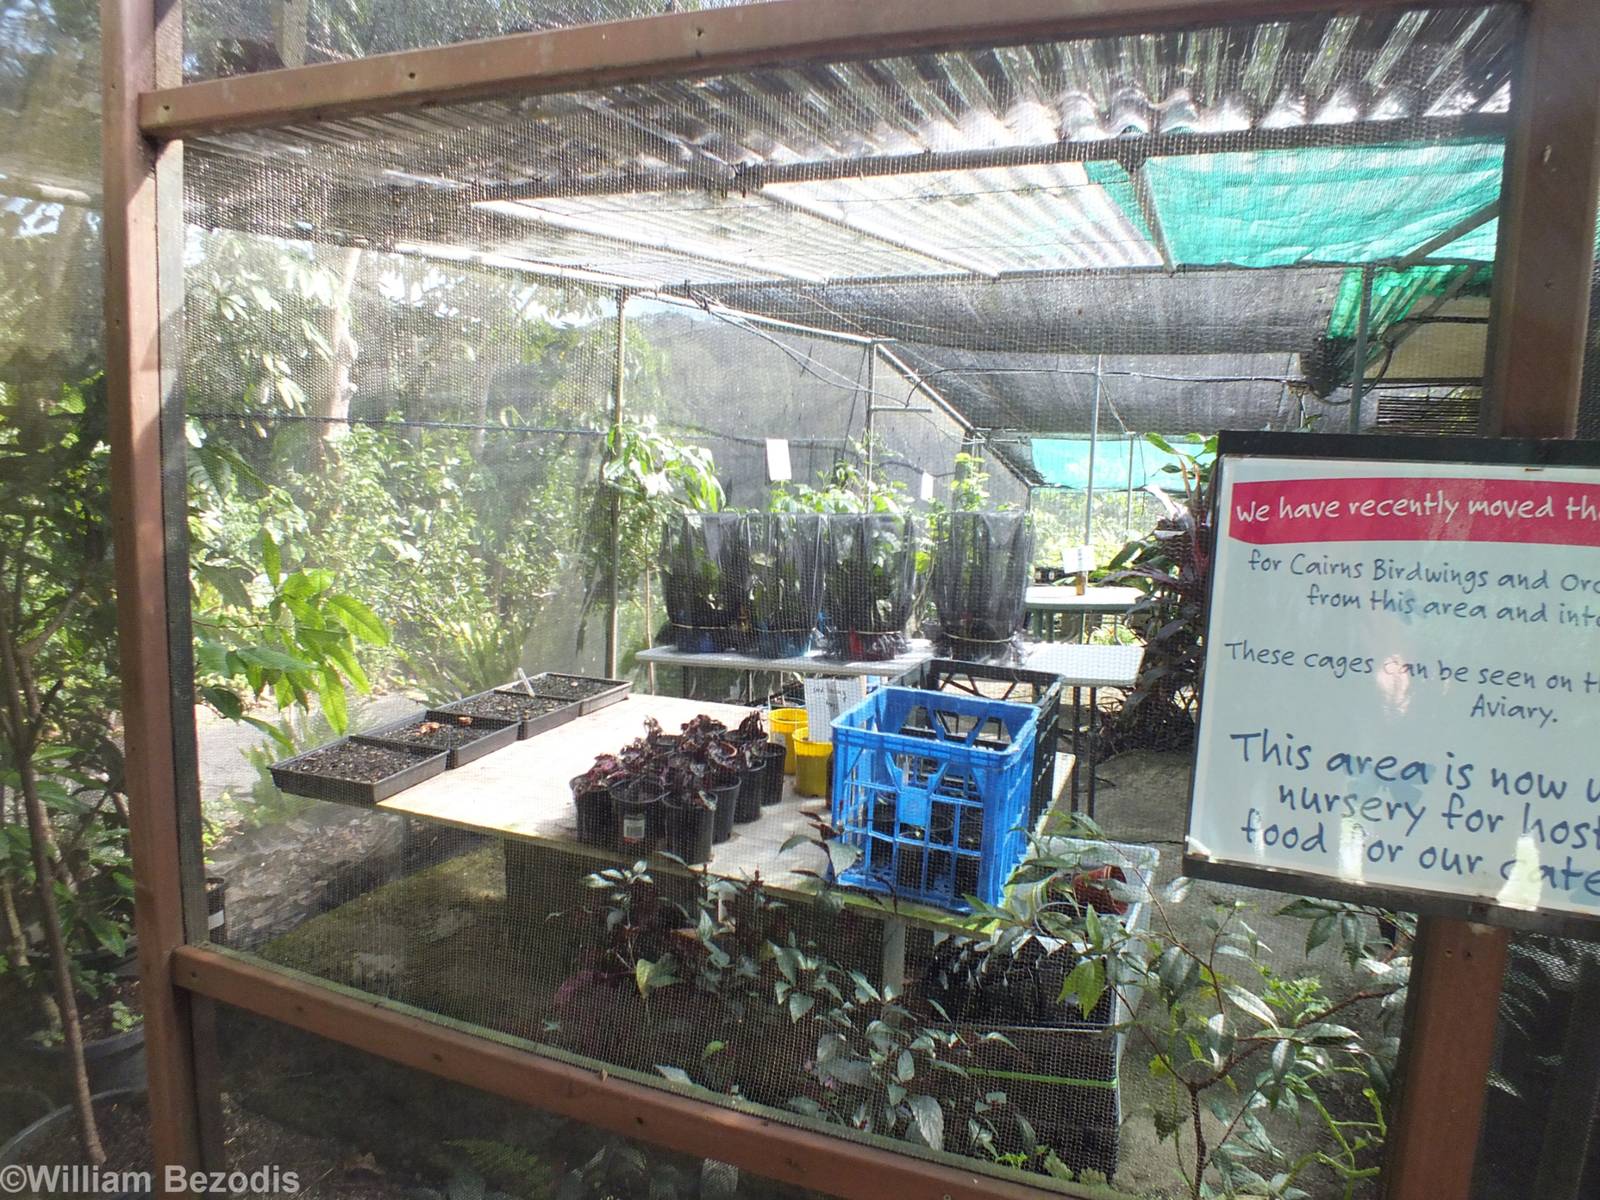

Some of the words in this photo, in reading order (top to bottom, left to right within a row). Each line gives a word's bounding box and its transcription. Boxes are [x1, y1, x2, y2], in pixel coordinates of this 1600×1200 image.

[1236, 501, 1270, 522] We
[1279, 496, 1340, 519] have
[1349, 490, 1459, 523] recently
[1469, 495, 1554, 519] moved
[1565, 495, 1600, 521] th
[1248, 549, 1282, 572] for
[1290, 553, 1363, 579] Cairns
[1373, 558, 1489, 594] Birdwings
[1498, 569, 1547, 591] and
[1306, 584, 1361, 610] from
[1369, 589, 1415, 614] this
[1423, 601, 1487, 619] area
[1496, 603, 1547, 623] and
[1224, 641, 1295, 666] These
[1304, 652, 1373, 678] cages
[1437, 660, 1469, 683] be
[1478, 667, 1536, 689] seen
[1546, 675, 1573, 693] on
[1470, 694, 1559, 728] Aviary.
[1230, 728, 1312, 771] This
[1326, 752, 1430, 785] area
[1445, 751, 1474, 790] is
[1491, 768, 1568, 800] now
[1279, 784, 1426, 837] nursery
[1442, 793, 1504, 833] for
[1241, 808, 1327, 853] food
[1419, 846, 1483, 876] our
